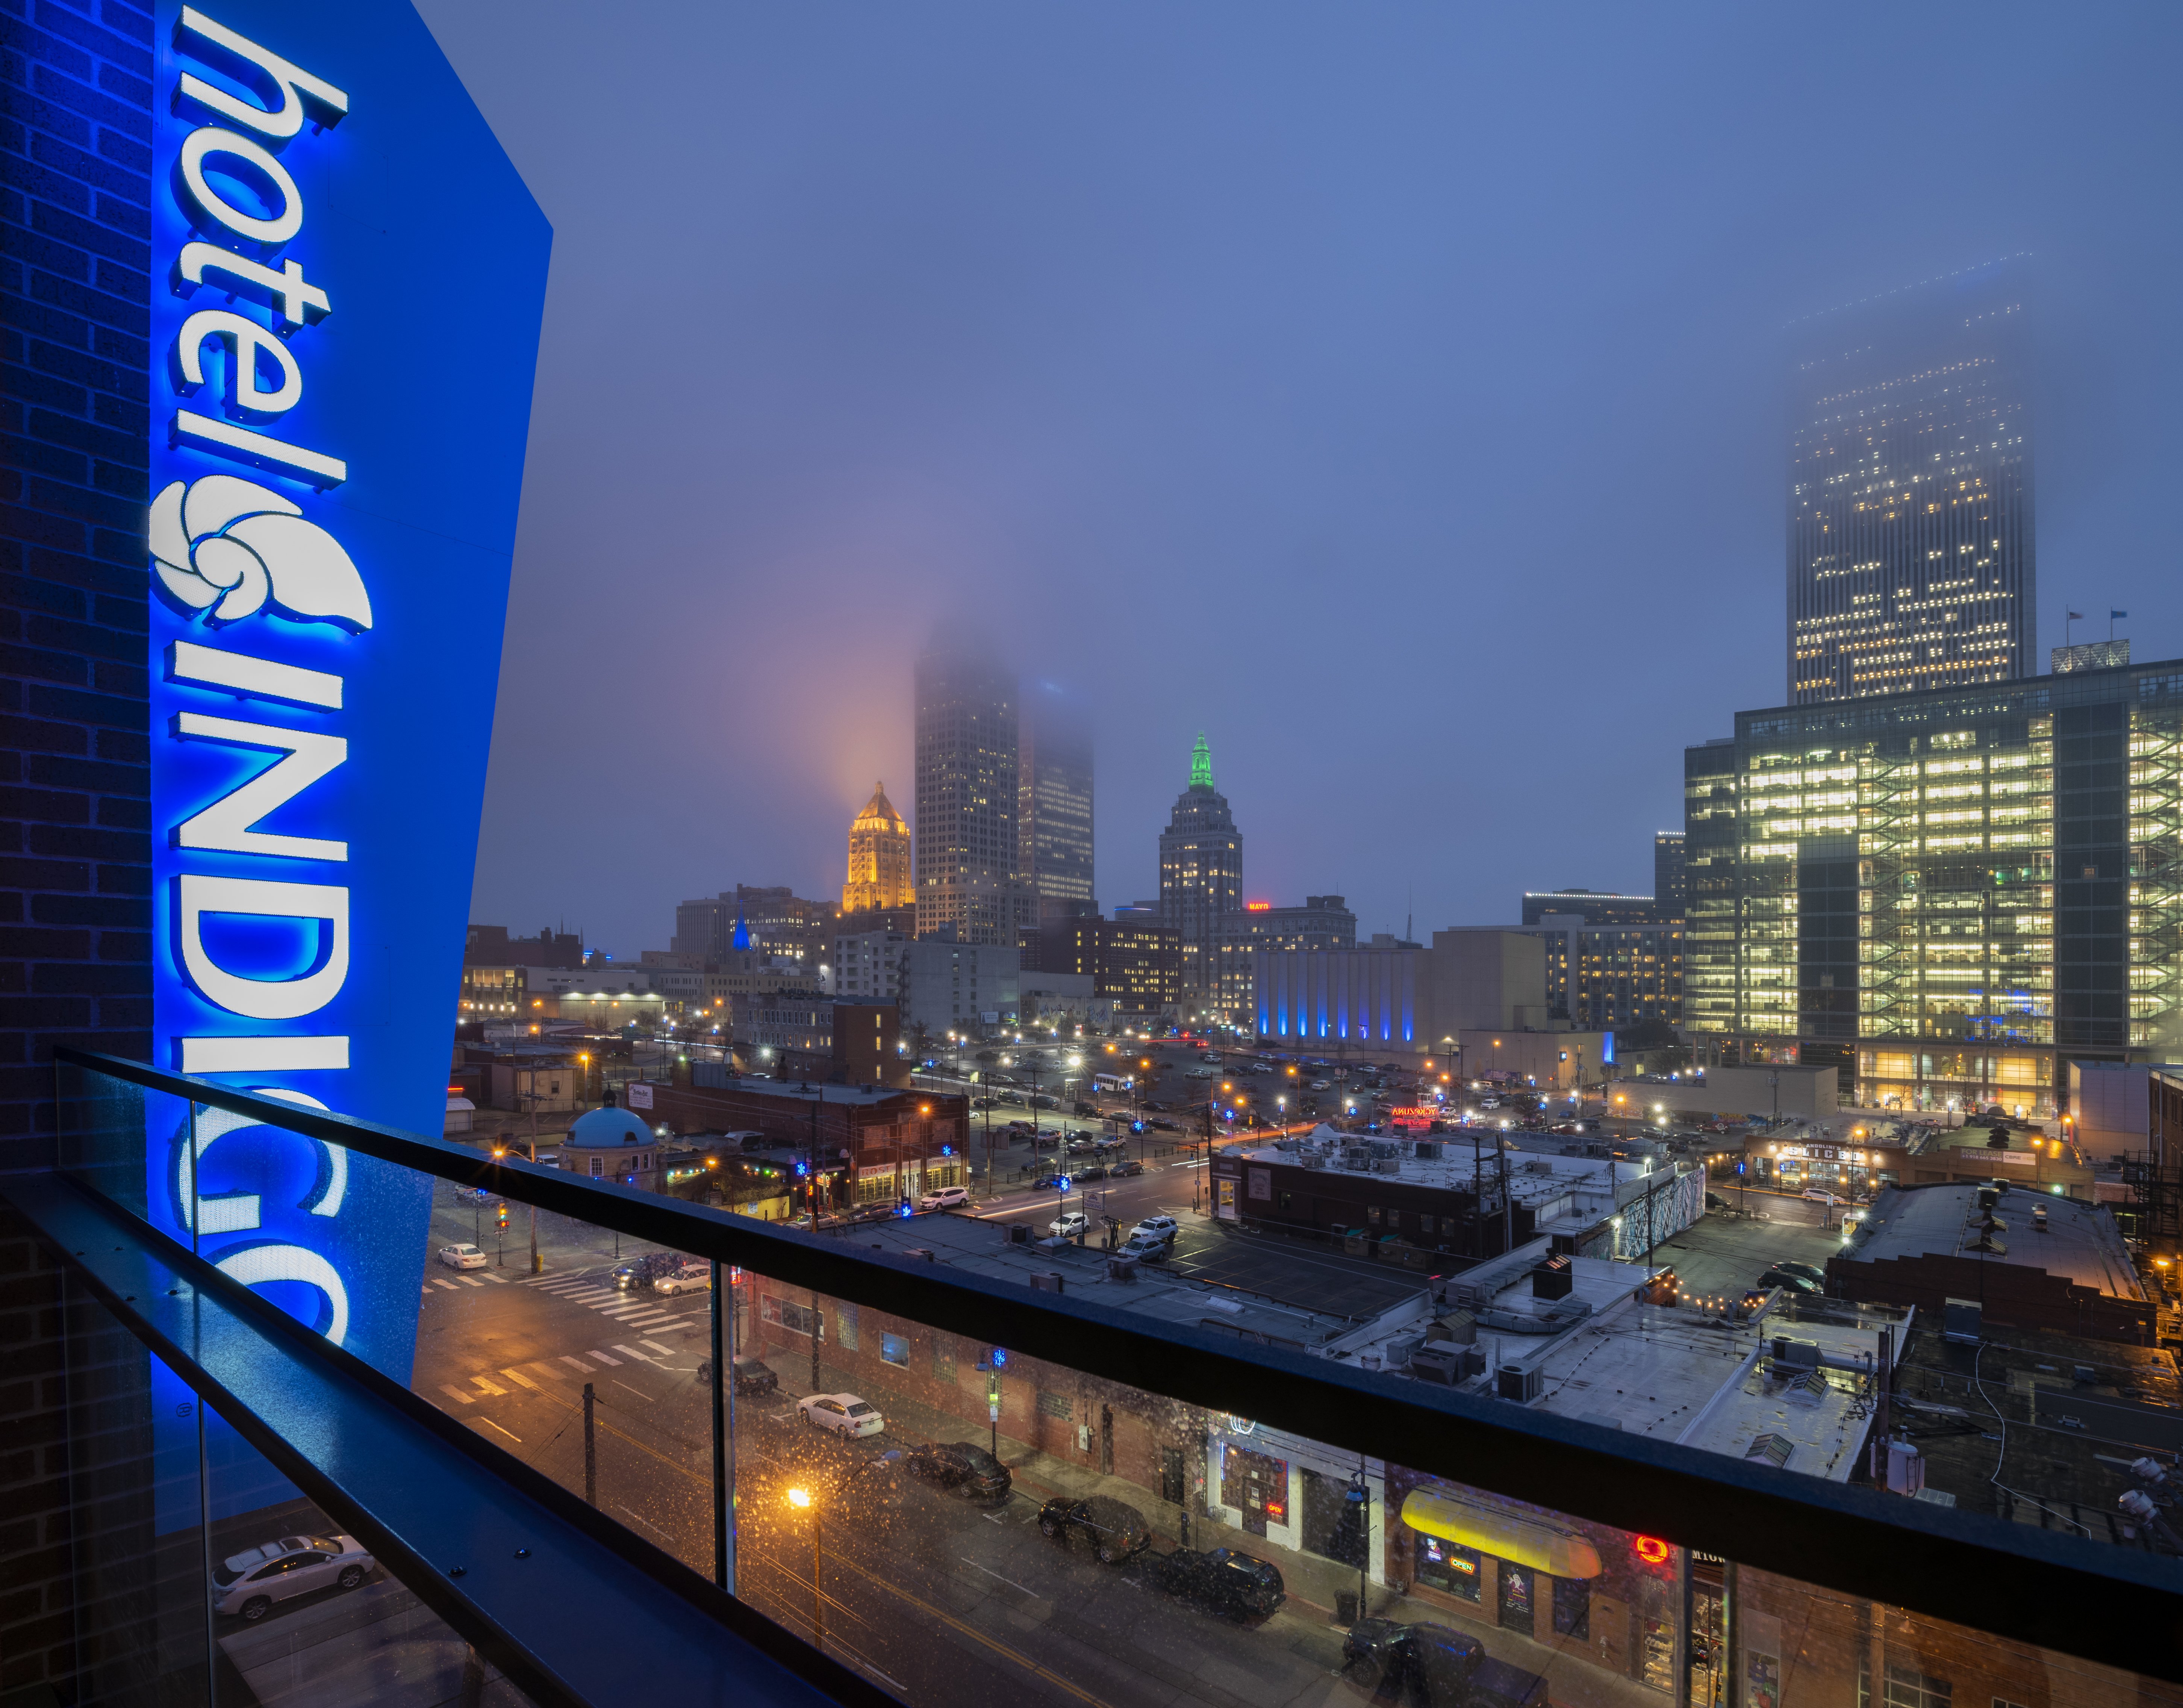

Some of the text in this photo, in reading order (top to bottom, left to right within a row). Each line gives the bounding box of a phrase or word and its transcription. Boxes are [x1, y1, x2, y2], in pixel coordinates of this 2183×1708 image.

[173, 4, 349, 490] hotel
[1789, 1147, 1860, 1161] SLICED
[1452, 1560, 1472, 1571] OPEN
